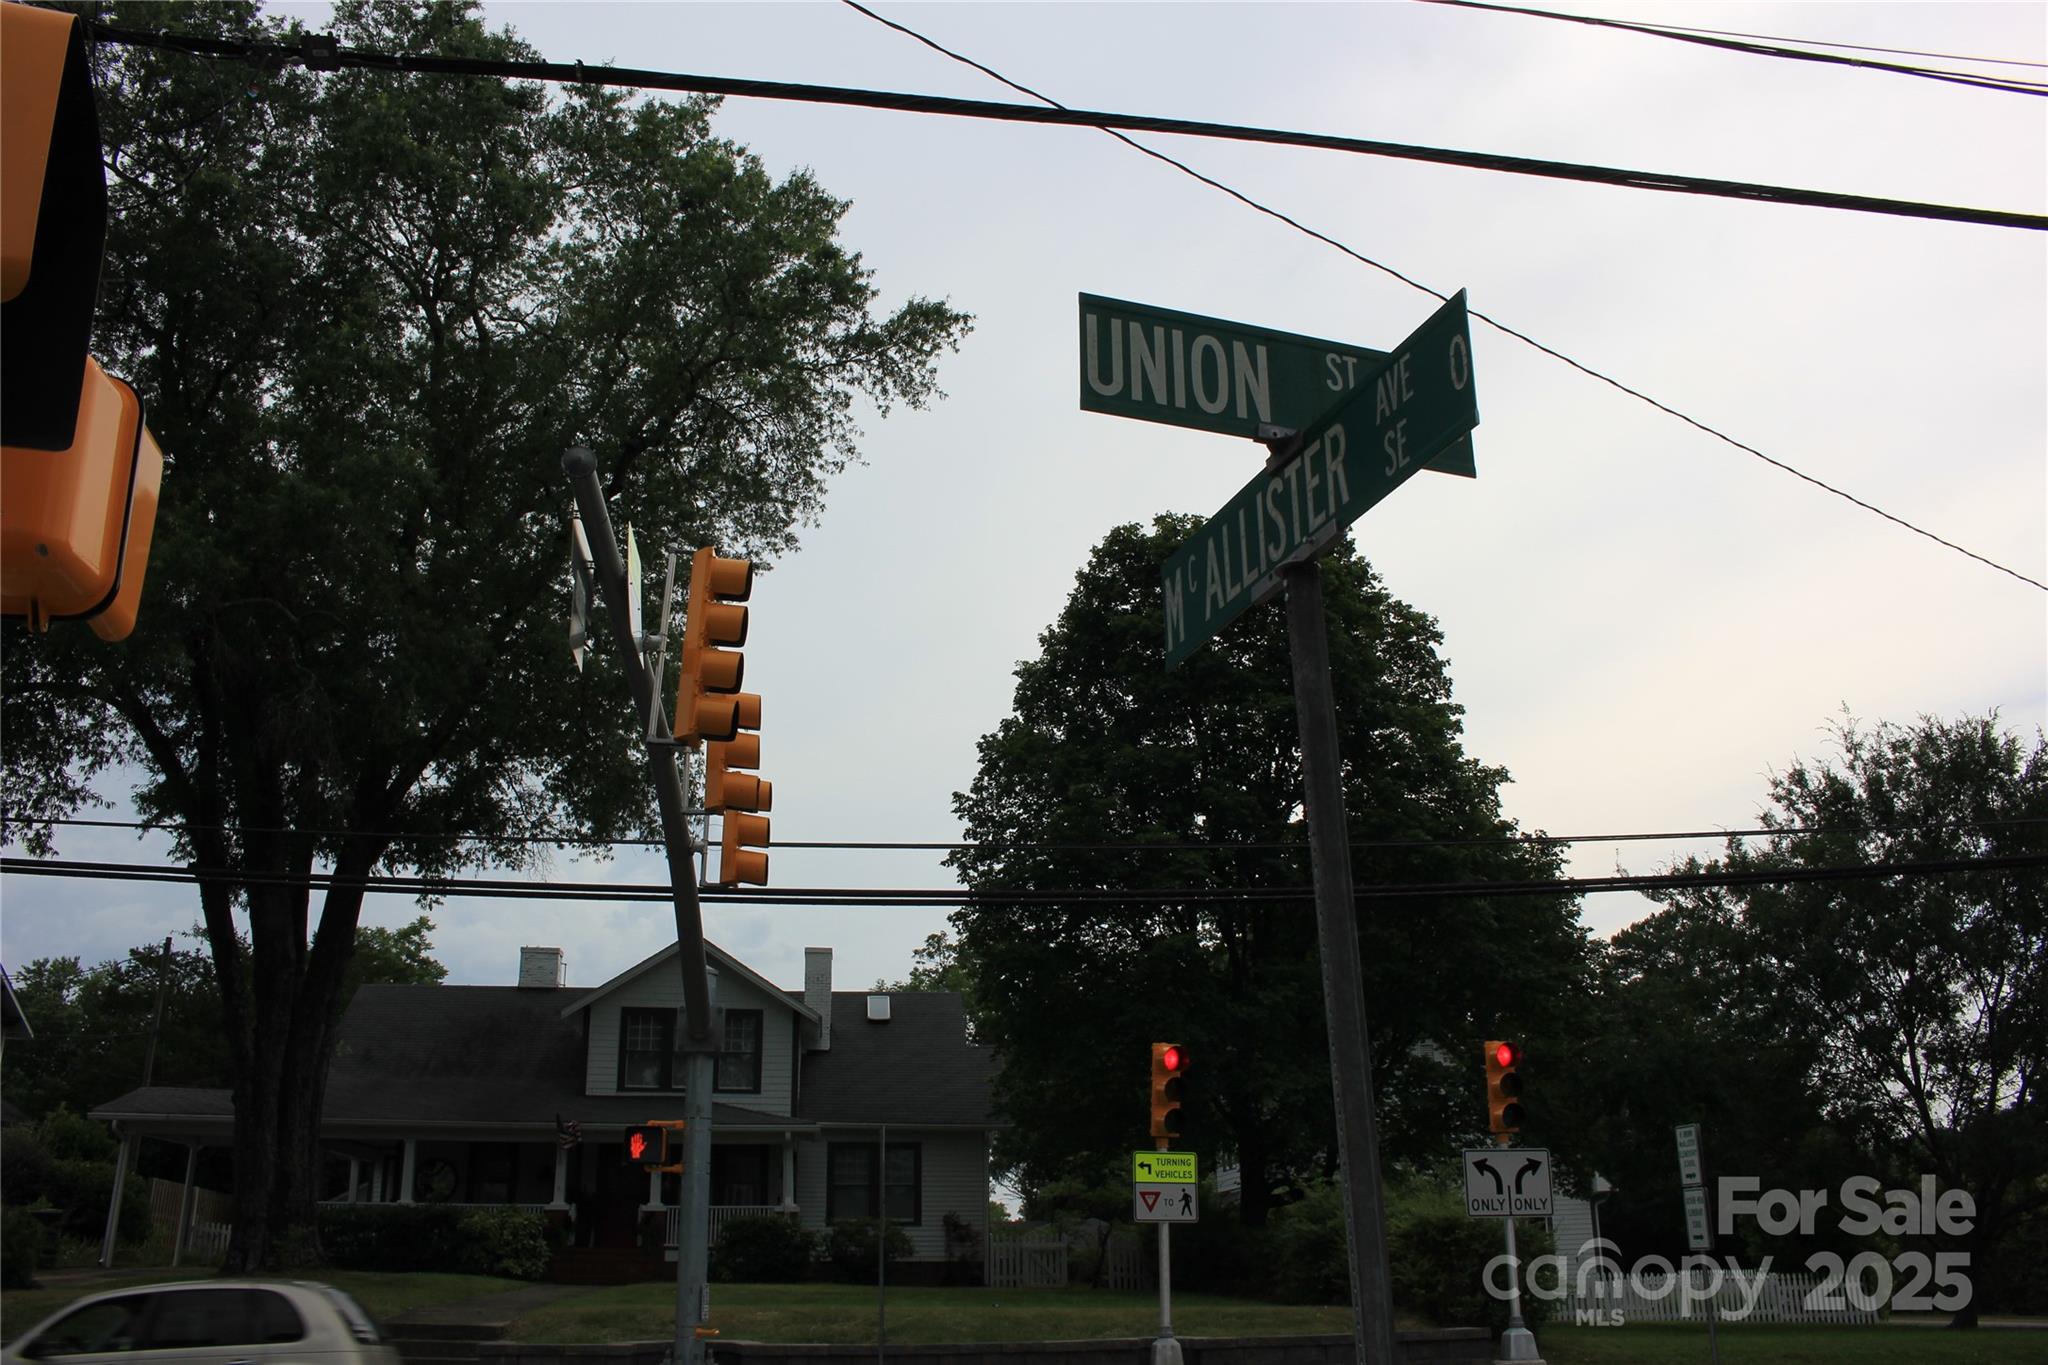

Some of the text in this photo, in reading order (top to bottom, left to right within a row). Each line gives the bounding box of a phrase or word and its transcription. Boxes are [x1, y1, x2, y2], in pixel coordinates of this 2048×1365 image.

[1085, 313, 1358, 423] UNION ST
[1375, 352, 1415, 427] AVE
[1383, 417, 1411, 477] SE
[1155, 1157, 1192, 1168] TURNING
[1154, 1170, 1193, 1179] VEHICLES
[1163, 1198, 1174, 1207] TO
[1471, 1198, 1506, 1212] ONLY
[1514, 1197, 1548, 1211] ONLY
